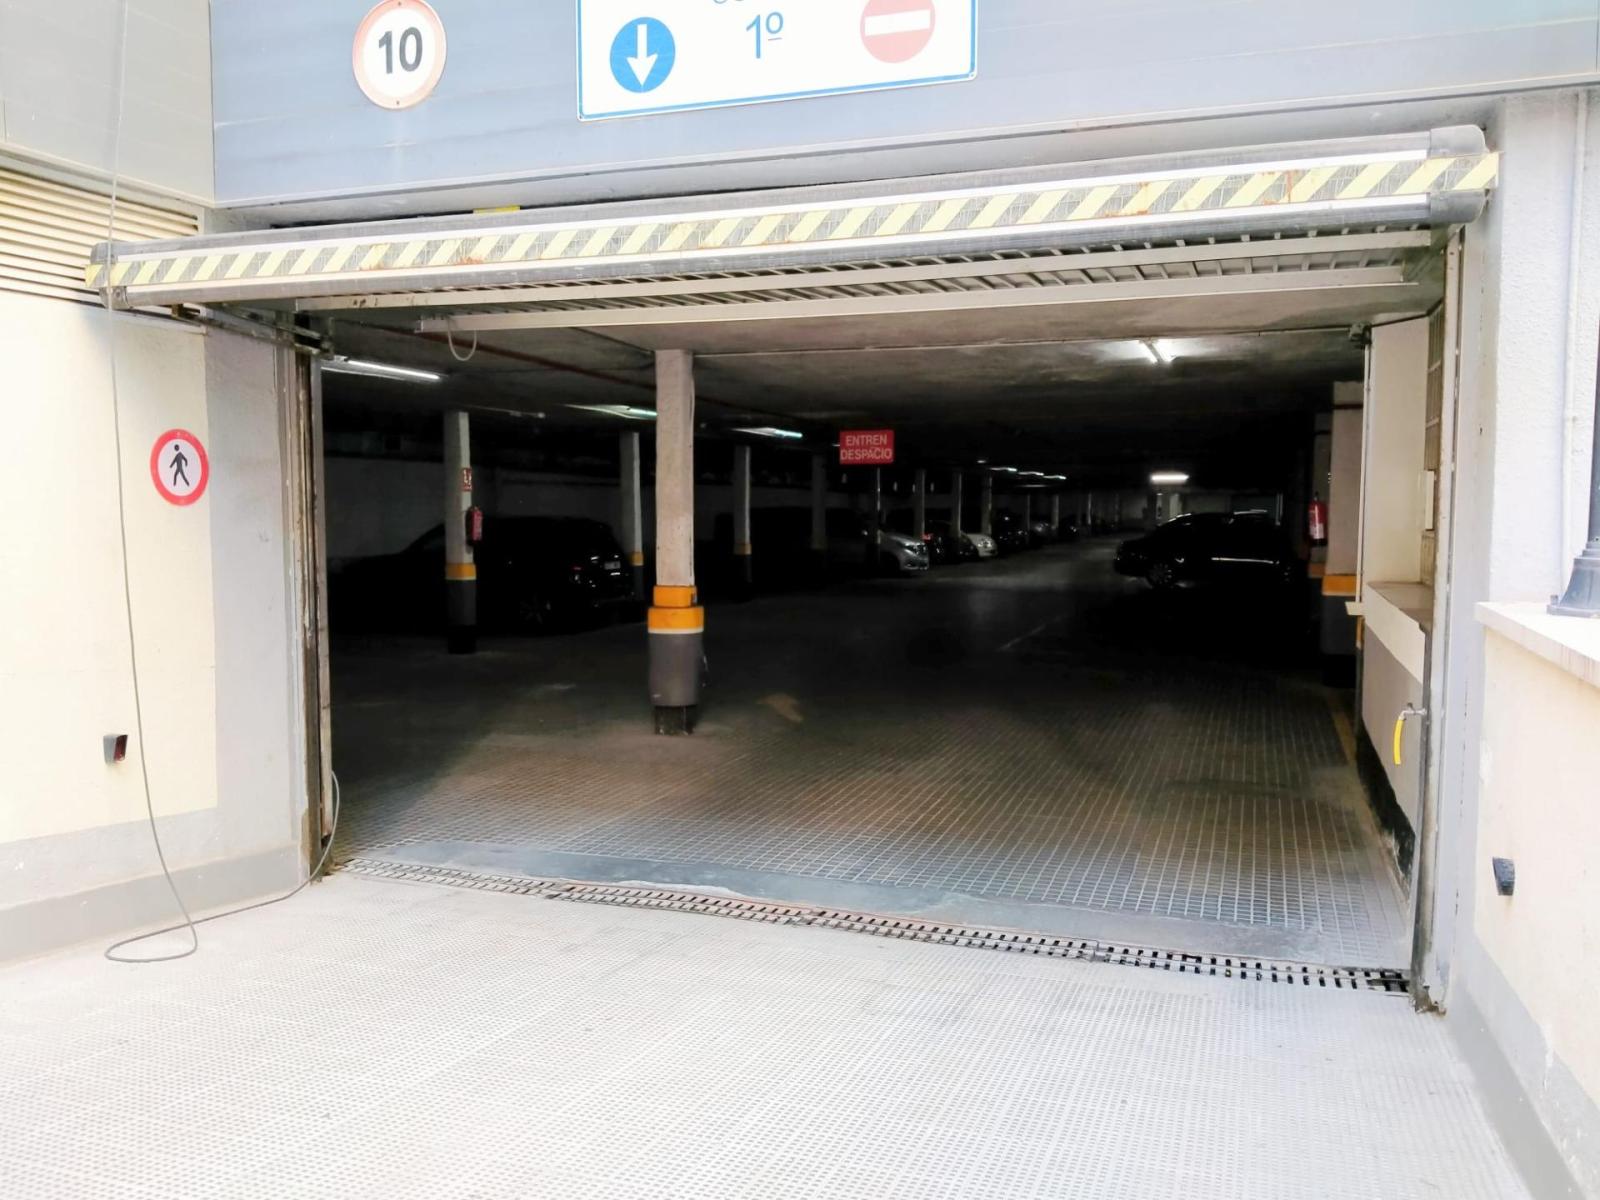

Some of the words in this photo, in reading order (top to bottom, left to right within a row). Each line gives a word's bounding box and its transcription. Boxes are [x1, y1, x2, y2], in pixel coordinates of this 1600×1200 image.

[378, 26, 423, 74] 10
[845, 433, 888, 447] ENTREN
[840, 447, 893, 460] DESPACIO
